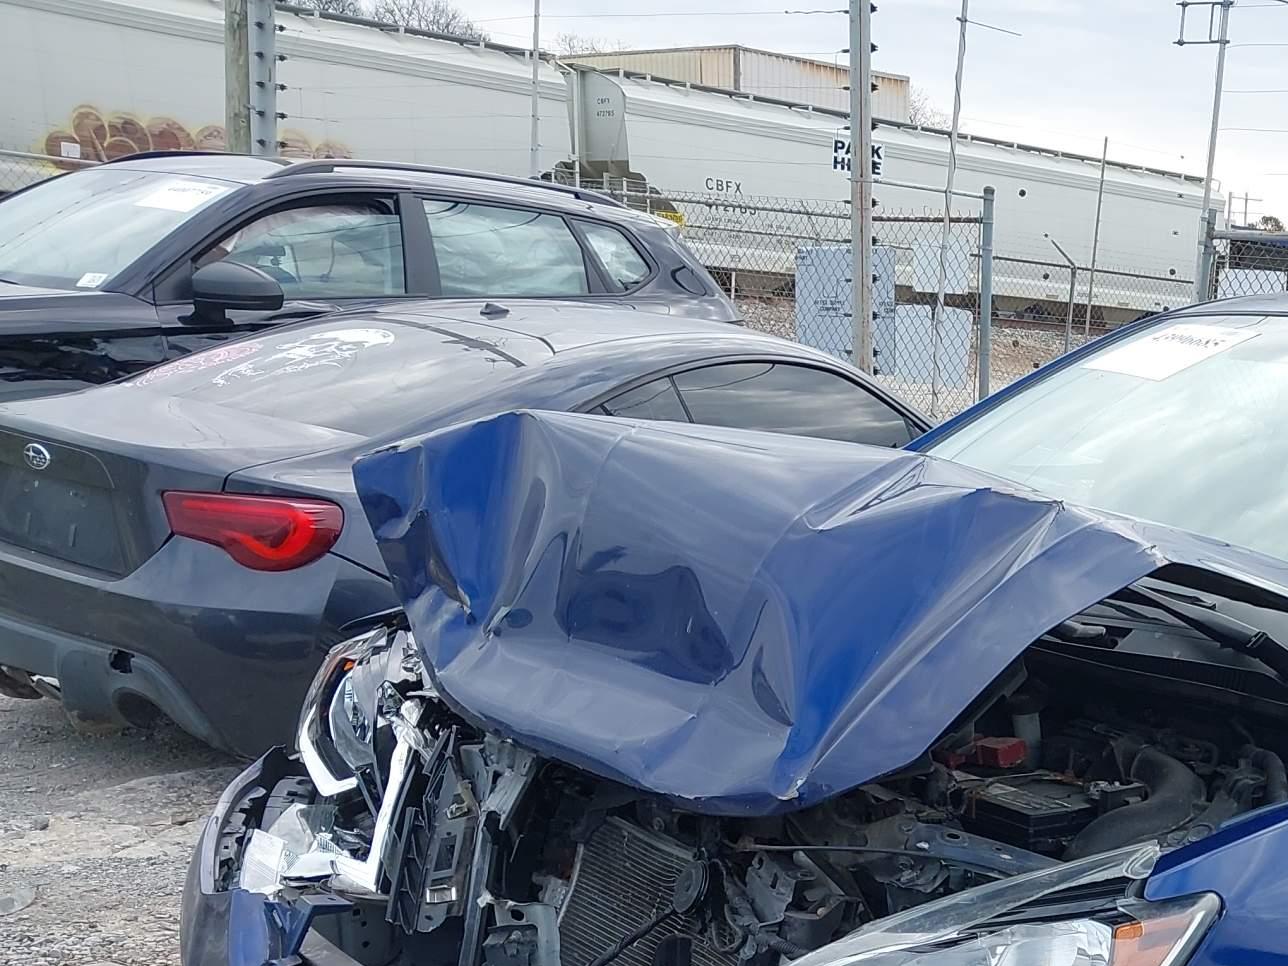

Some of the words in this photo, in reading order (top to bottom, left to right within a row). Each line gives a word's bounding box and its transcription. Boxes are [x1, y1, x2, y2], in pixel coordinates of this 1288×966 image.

[834, 140, 882, 160] PK
[833, 156, 881, 175] HE
[705, 178, 742, 194] CBFX
